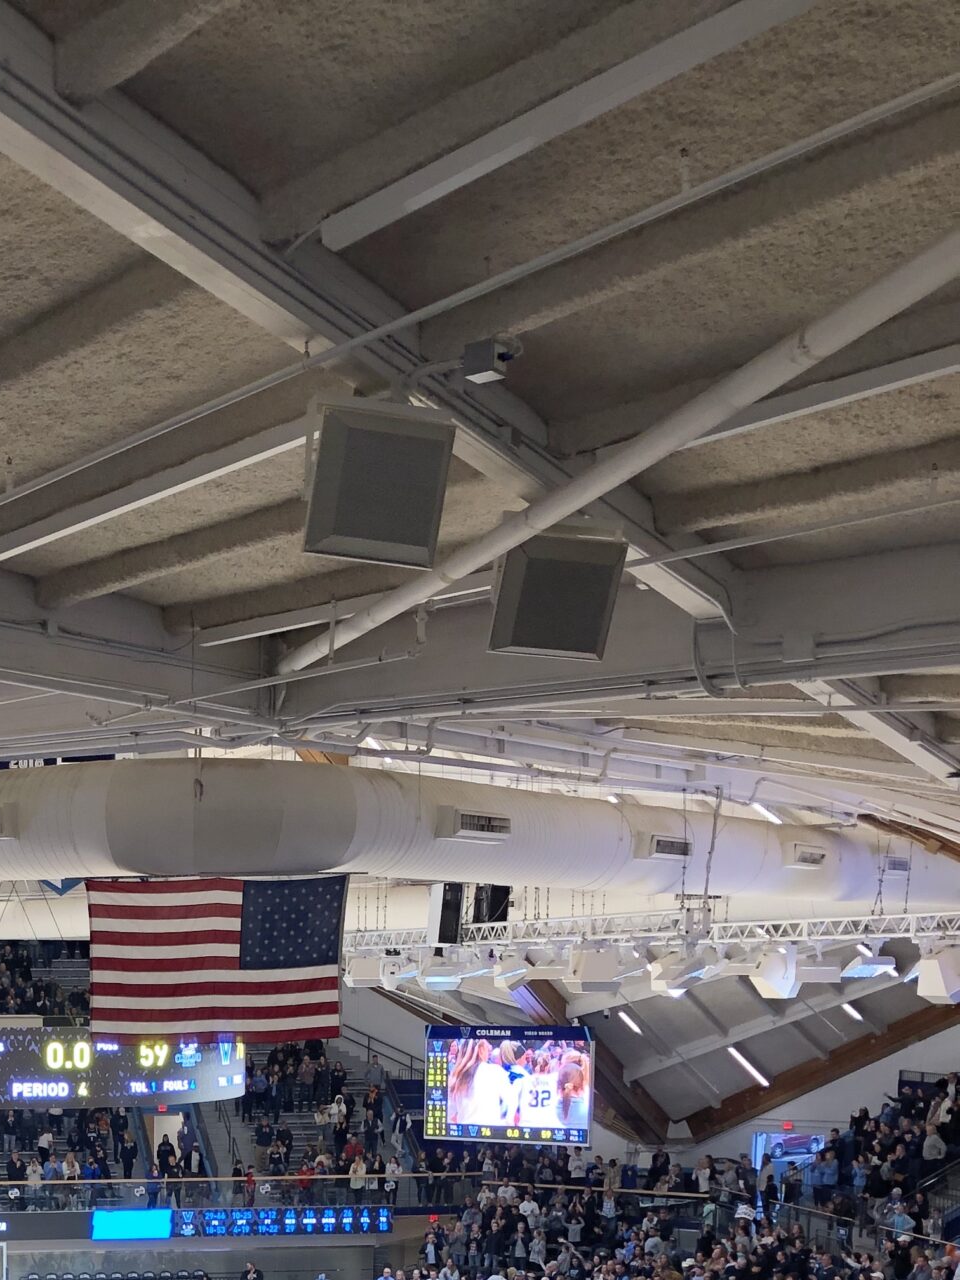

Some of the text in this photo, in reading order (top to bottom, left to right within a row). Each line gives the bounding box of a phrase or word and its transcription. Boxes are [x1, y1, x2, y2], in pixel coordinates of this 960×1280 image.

[46, 1042, 90, 1069] 0.0
[140, 1044, 168, 1067] 59
[12, 1082, 87, 1097] PERIOD 4
[130, 1082, 148, 1093] TOL
[164, 1080, 188, 1091] FOULS
[529, 1090, 551, 1107] 32
[481, 1128, 491, 1136] 76
[542, 1130, 551, 1138] 59
